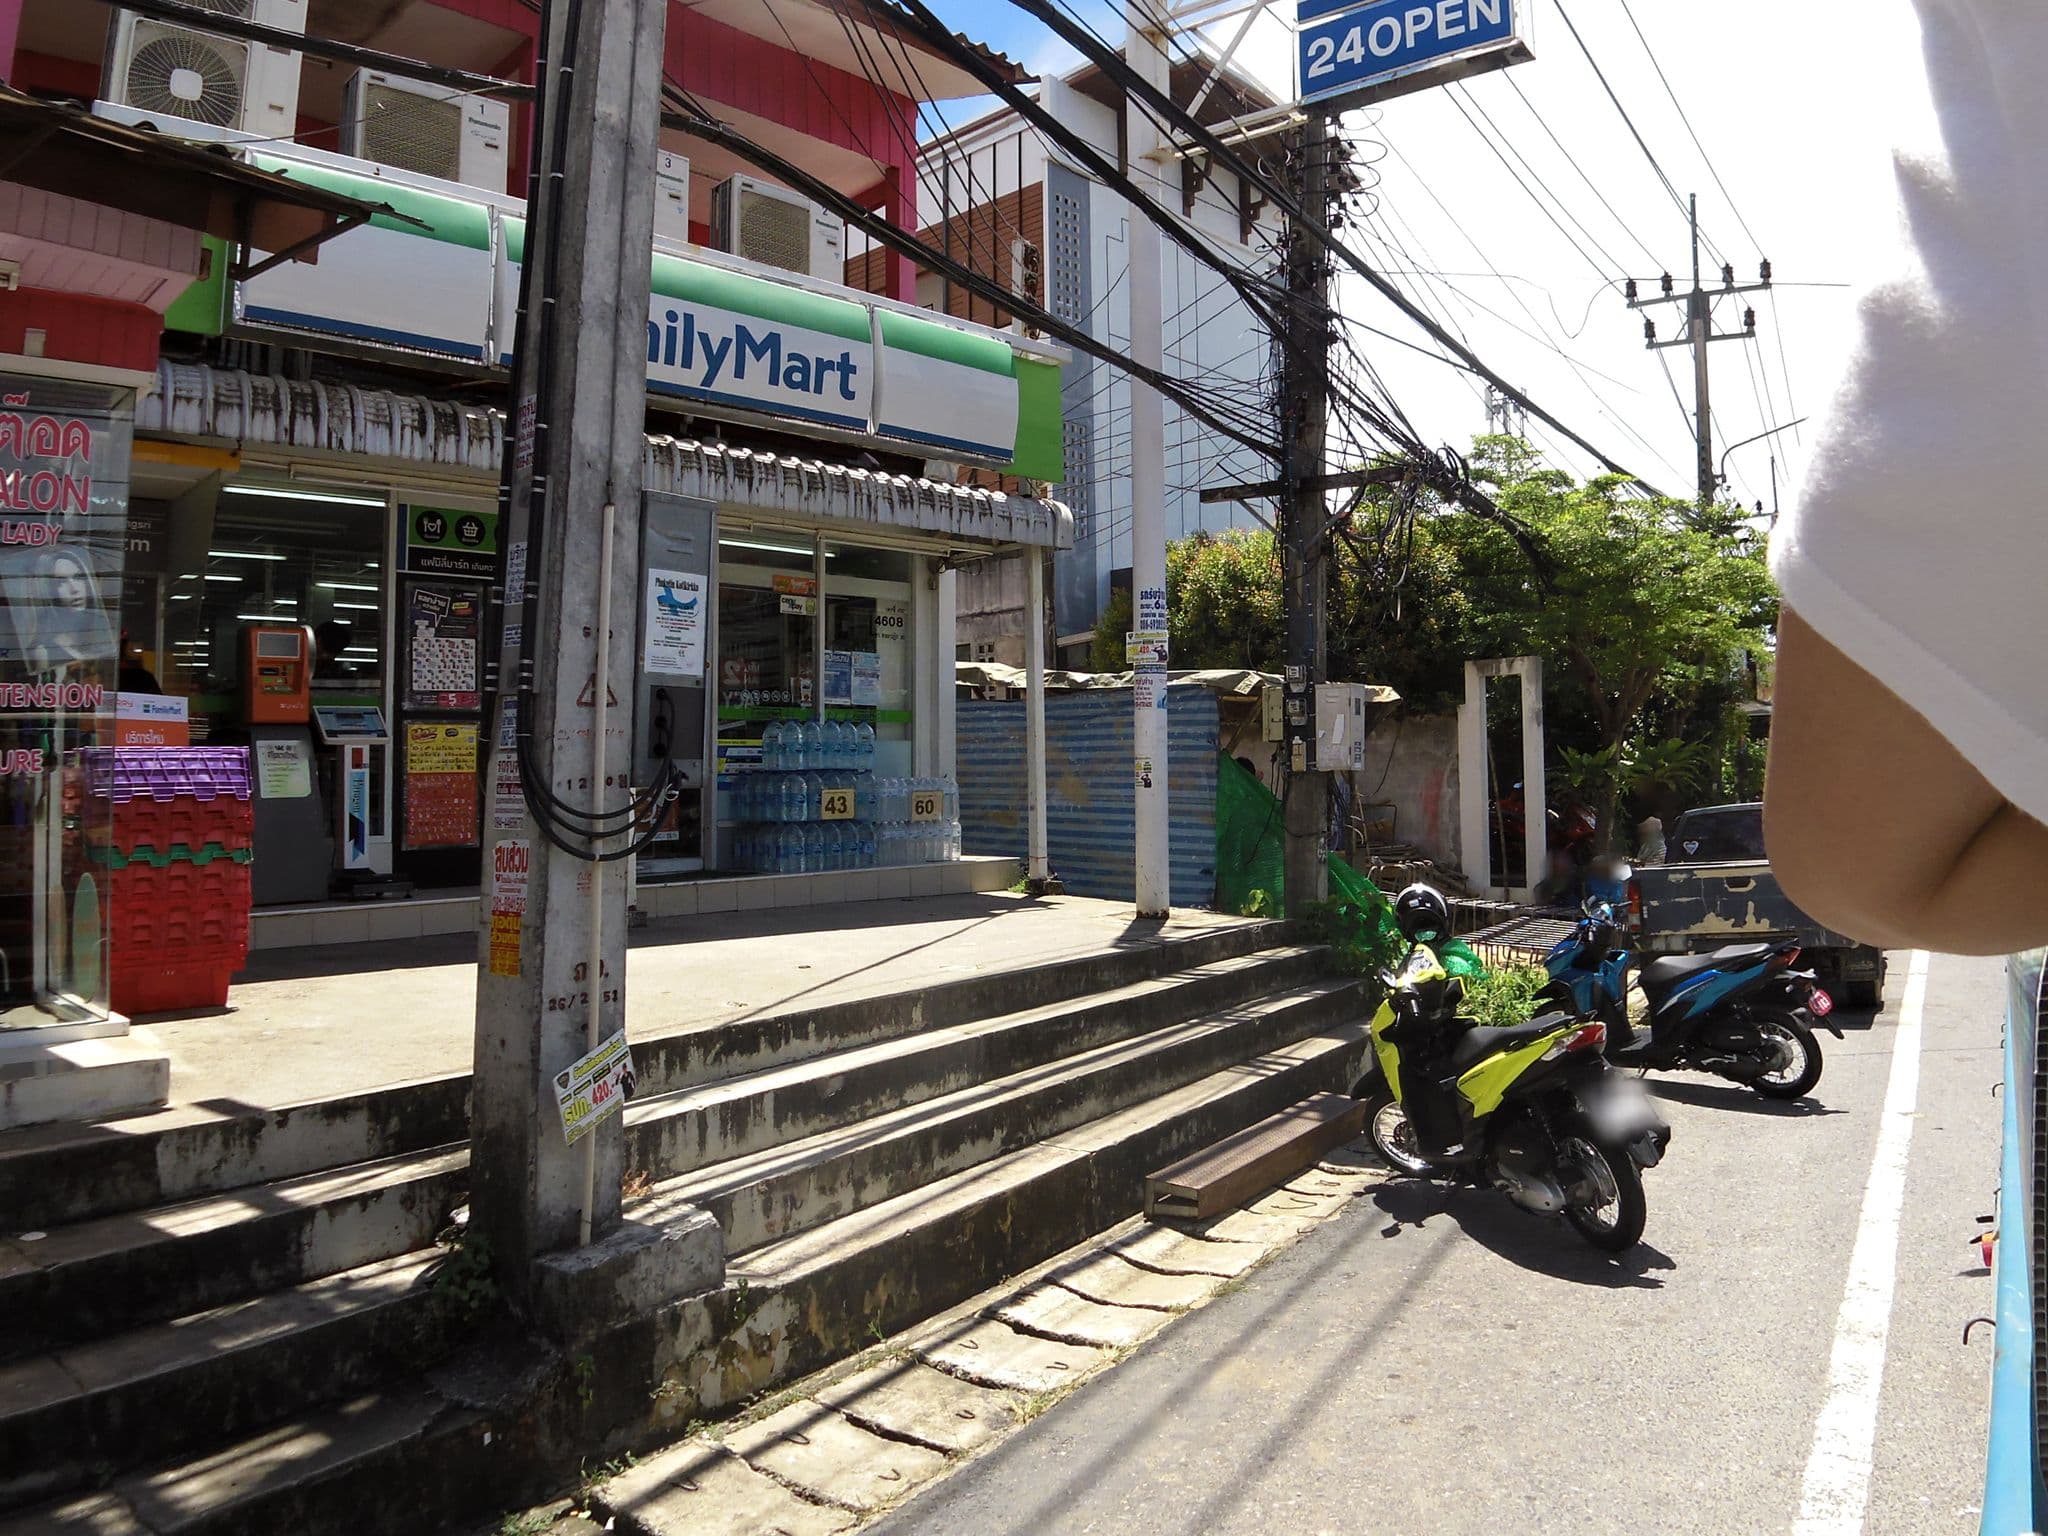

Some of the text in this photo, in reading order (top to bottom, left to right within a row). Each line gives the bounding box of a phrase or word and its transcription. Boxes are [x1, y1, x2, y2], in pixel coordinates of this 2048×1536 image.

[479, 103, 485, 115] 1
[665, 157, 672, 169] 3
[2, 520, 62, 547] LADY
[874, 615, 904, 629] 4608
[0, 682, 105, 710] TENSION
[824, 796, 848, 815] 43
[915, 799, 935, 815] 60
